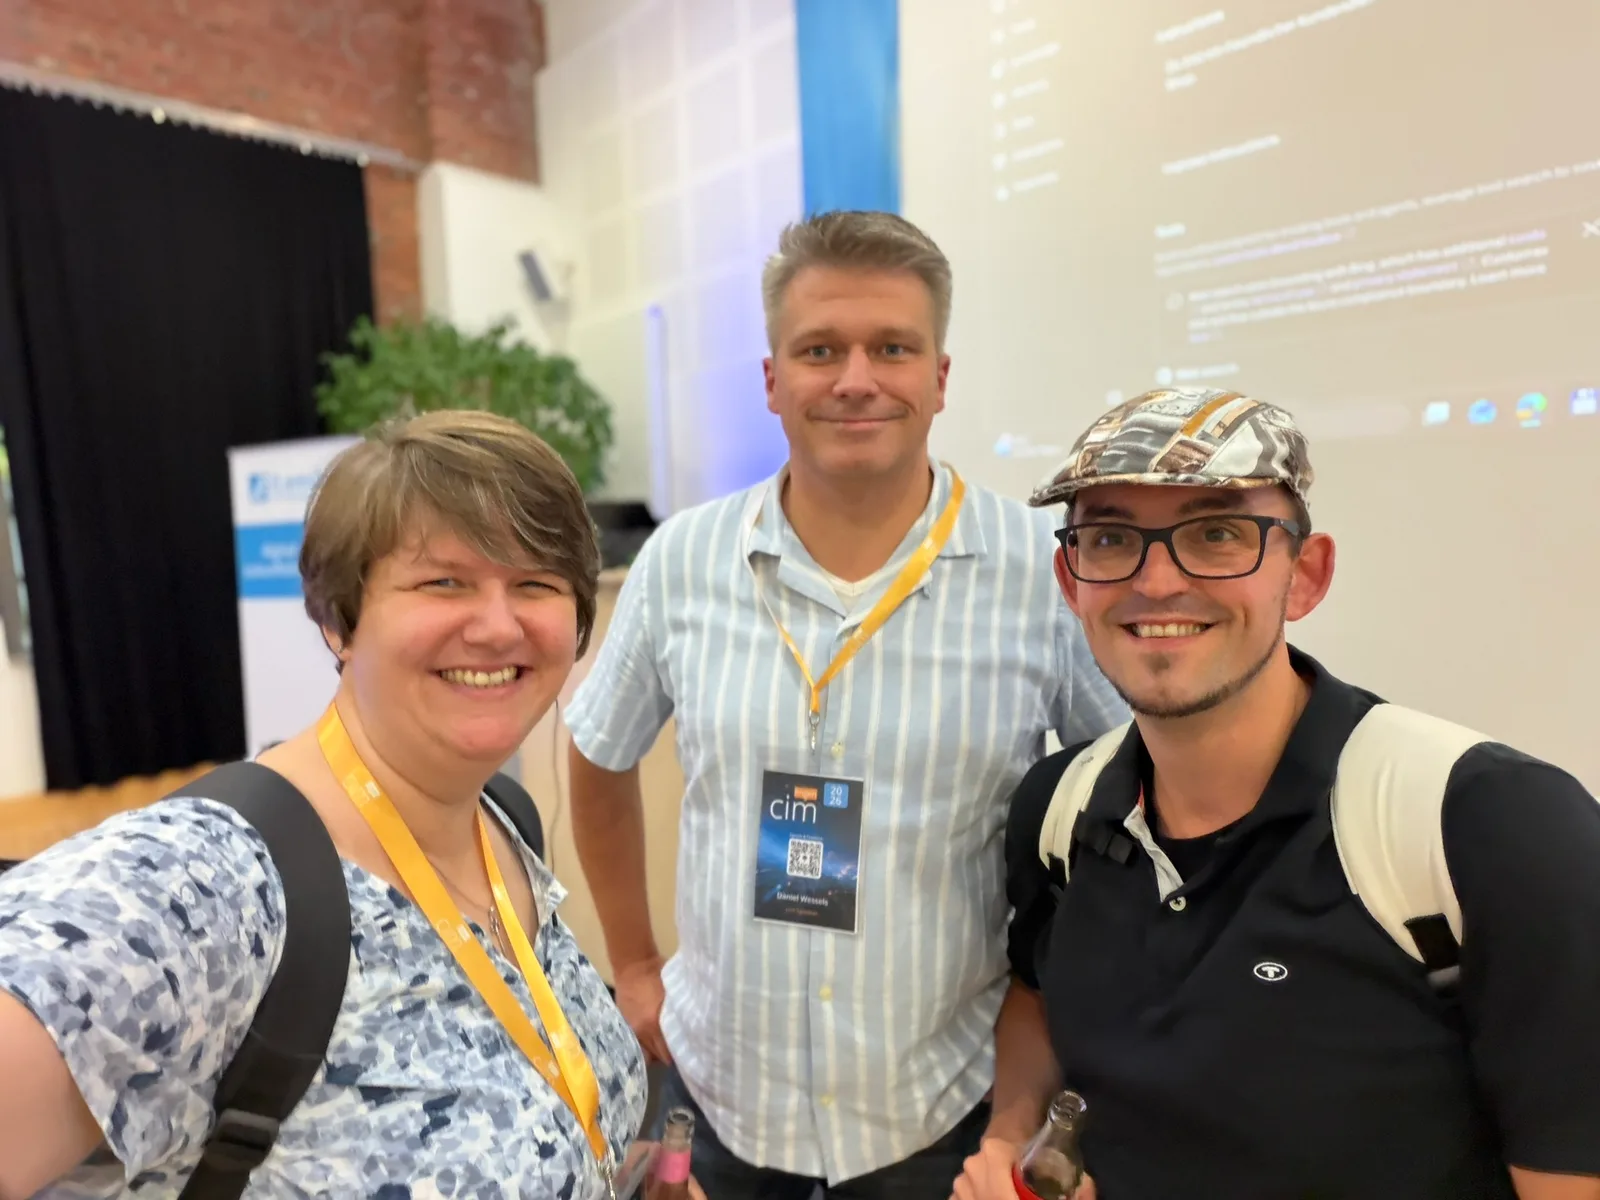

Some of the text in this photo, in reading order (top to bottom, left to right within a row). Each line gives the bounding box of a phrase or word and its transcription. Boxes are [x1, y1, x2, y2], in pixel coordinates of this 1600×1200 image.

[830, 787, 842, 797] 20
[829, 796, 841, 806] 26
[769, 793, 817, 824] cim
[777, 891, 829, 907] Daniel Wessels
